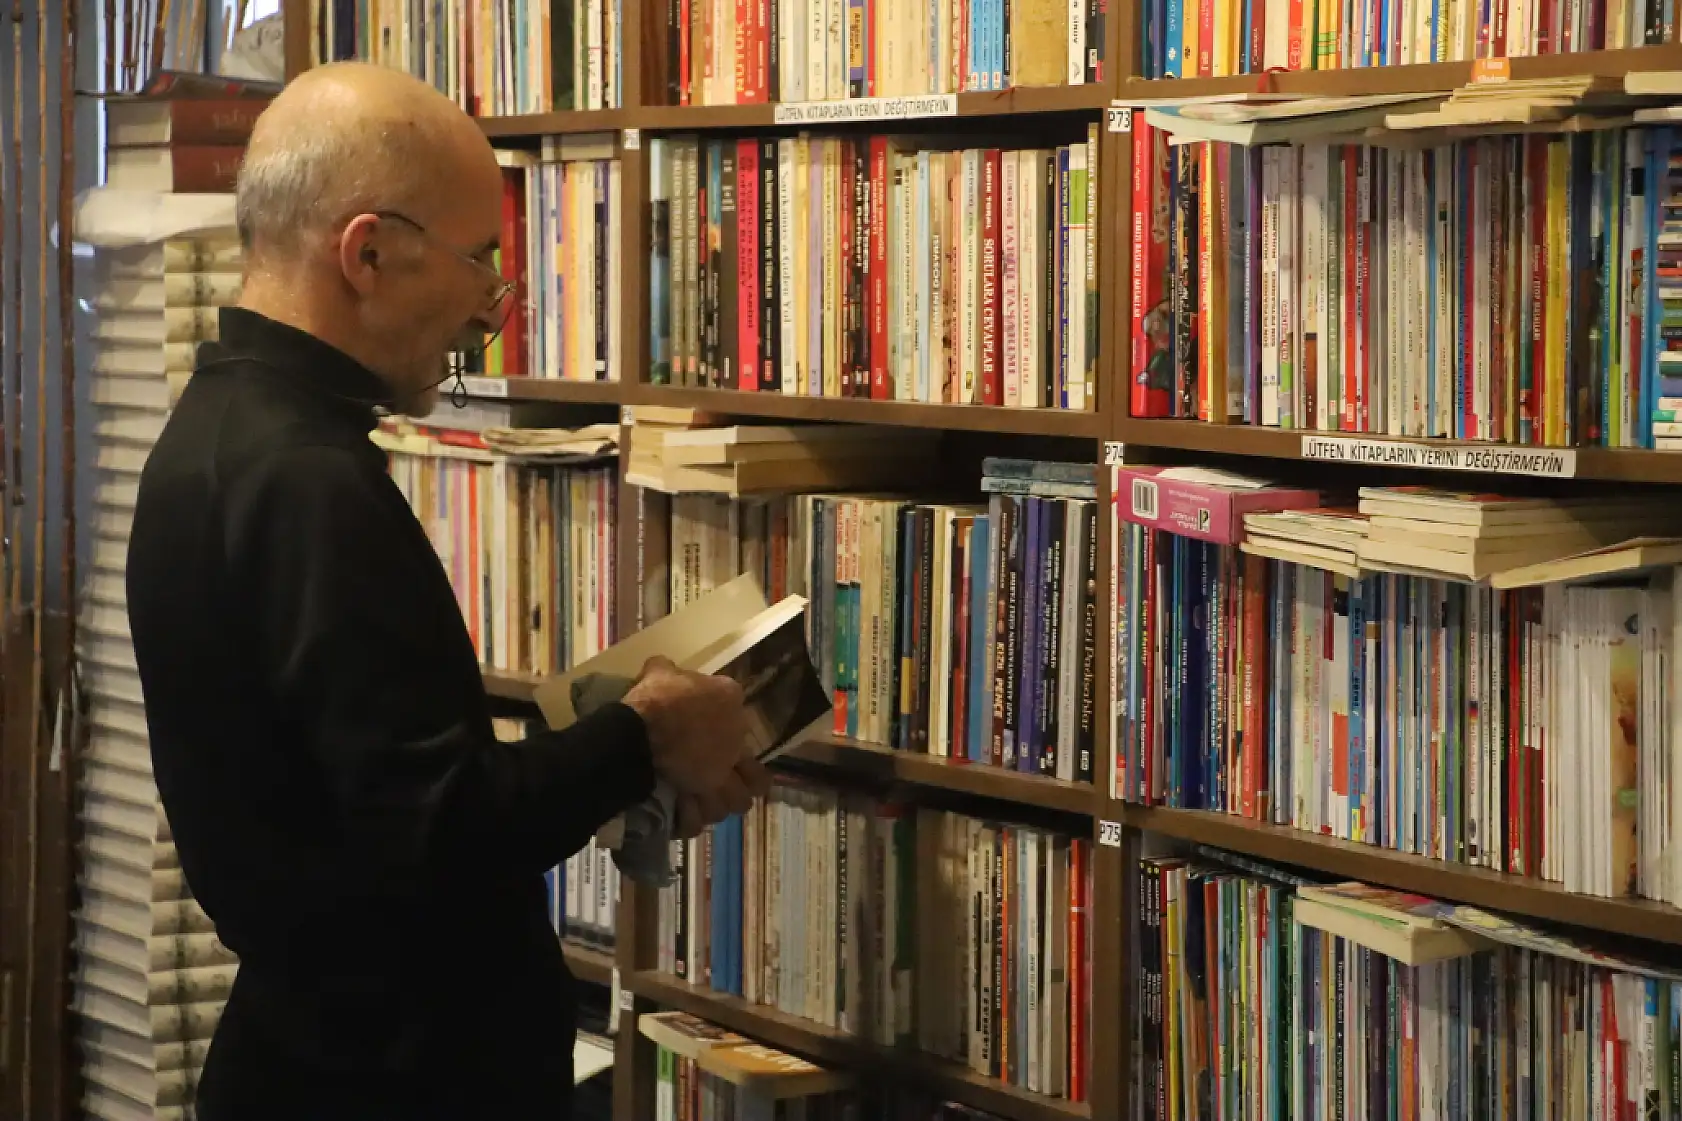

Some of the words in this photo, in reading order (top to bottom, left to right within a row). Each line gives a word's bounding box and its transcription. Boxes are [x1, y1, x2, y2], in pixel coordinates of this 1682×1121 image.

[983, 238, 995, 305] SORULARA
[983, 307, 995, 373] CEVAPLAR
[1350, 440, 1417, 465] KİTAPLARIN
[1420, 449, 1460, 468] YERİNİ
[1465, 450, 1564, 475] DEĞİŞTİRMEYİN
[1085, 602, 1096, 642] Gazi
